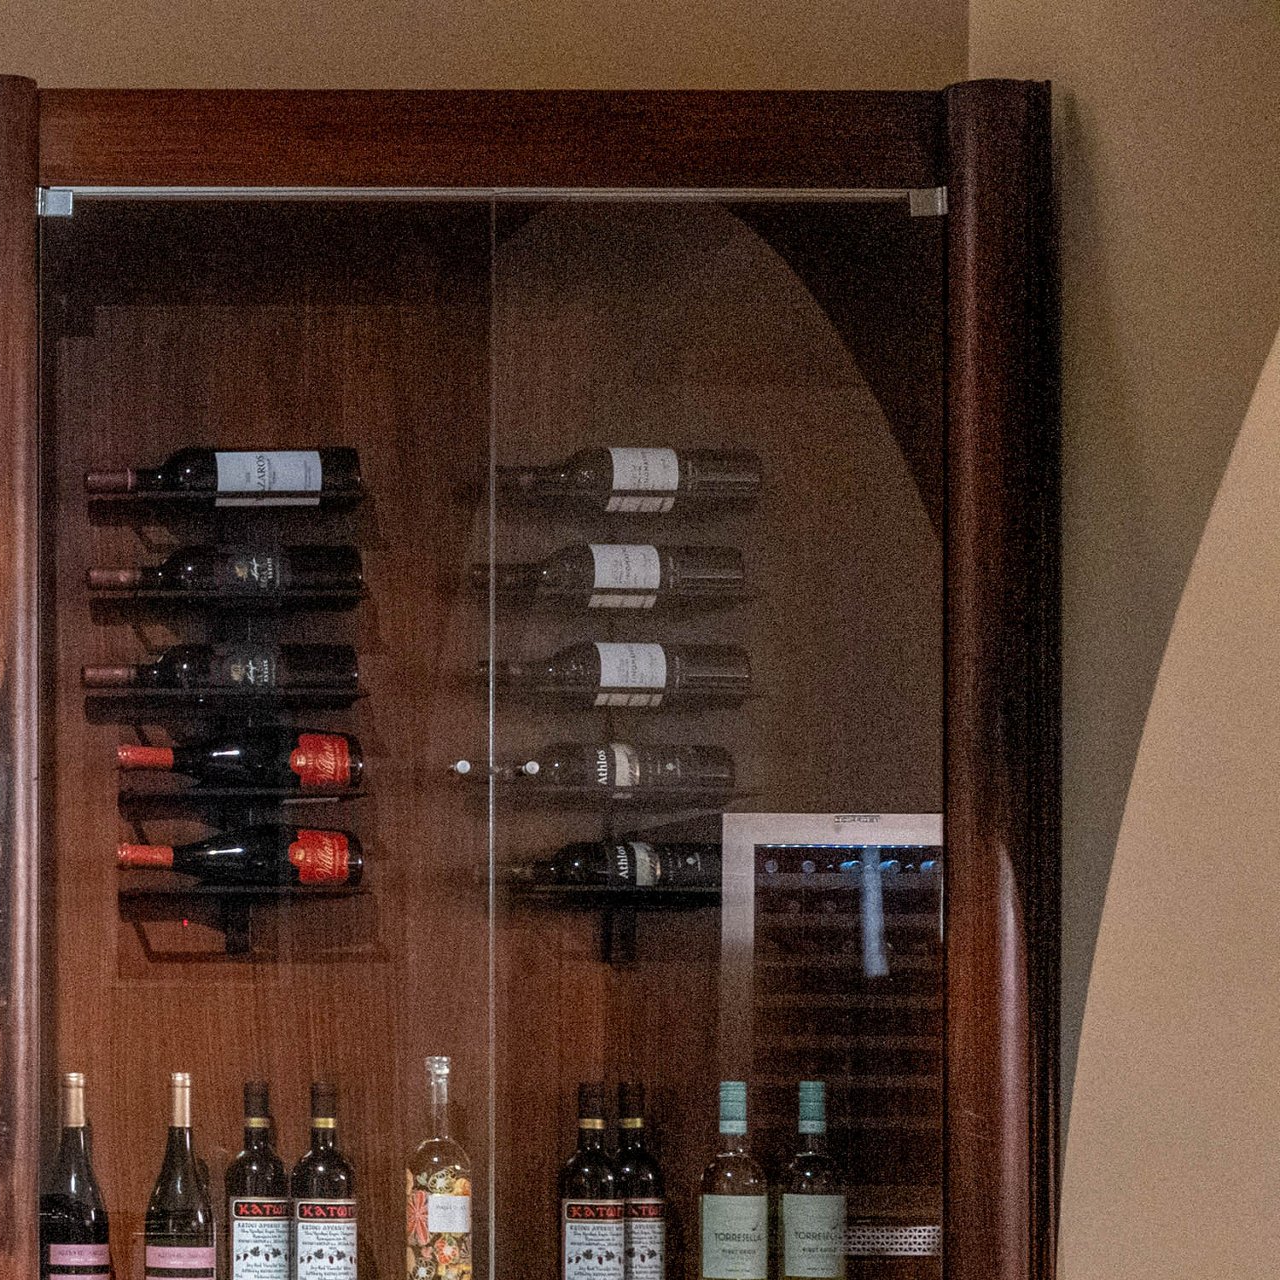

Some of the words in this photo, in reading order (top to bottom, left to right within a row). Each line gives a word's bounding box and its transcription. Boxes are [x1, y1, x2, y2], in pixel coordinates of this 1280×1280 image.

[256, 455, 266, 500] ZAROS
[596, 750, 608, 785] Athlos
[615, 846, 629, 880] Athlos
[714, 1232, 762, 1242] TORRESELLA
